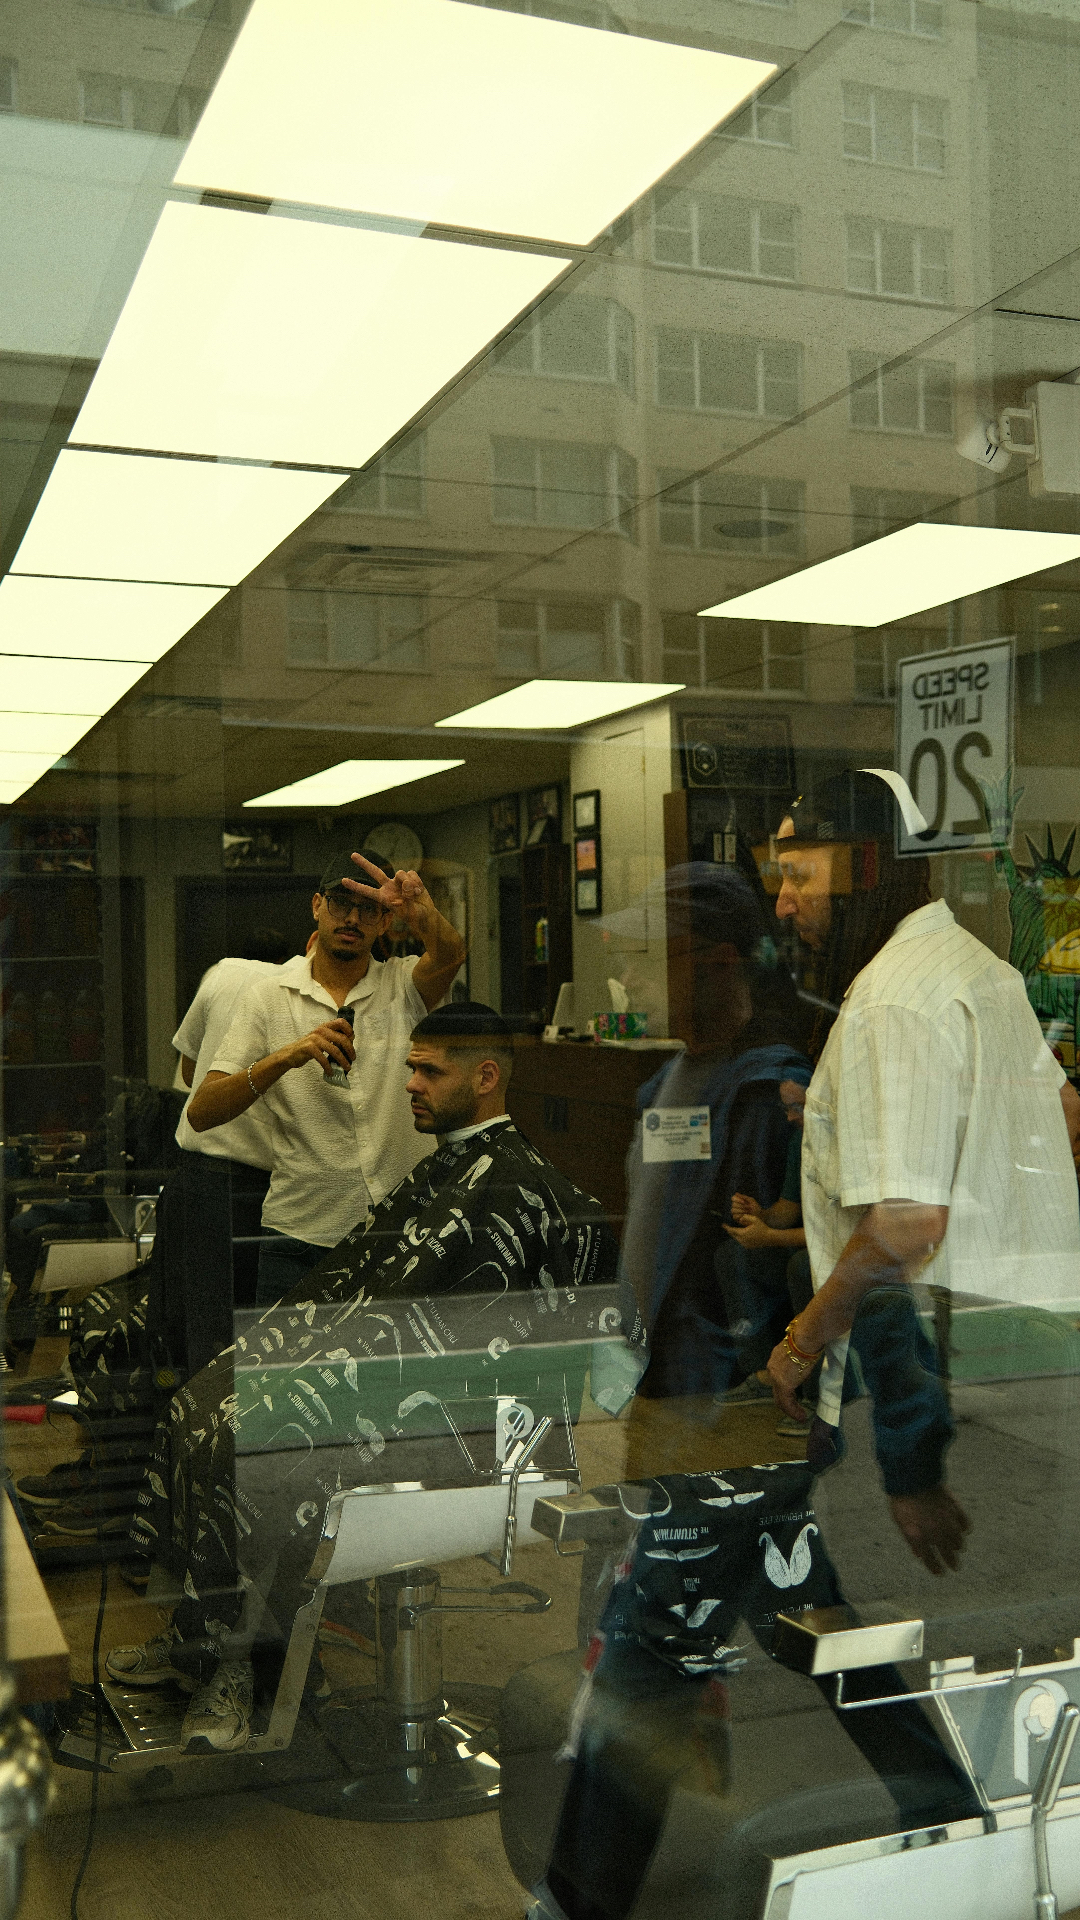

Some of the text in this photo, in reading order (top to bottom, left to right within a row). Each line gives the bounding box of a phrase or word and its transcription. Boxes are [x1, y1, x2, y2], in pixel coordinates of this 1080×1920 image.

[490, 1231, 517, 1267] STUNTMAN
[443, 1328, 459, 1344] CHU
[290, 1394, 321, 1427] STUNTMAN
[358, 1447, 374, 1464] CHIP
[246, 1501, 263, 1520] CHU
[773, 1511, 804, 1524] PRIVATE
[652, 1527, 698, 1542] STUNTMAN
[803, 1602, 814, 1610] THE
